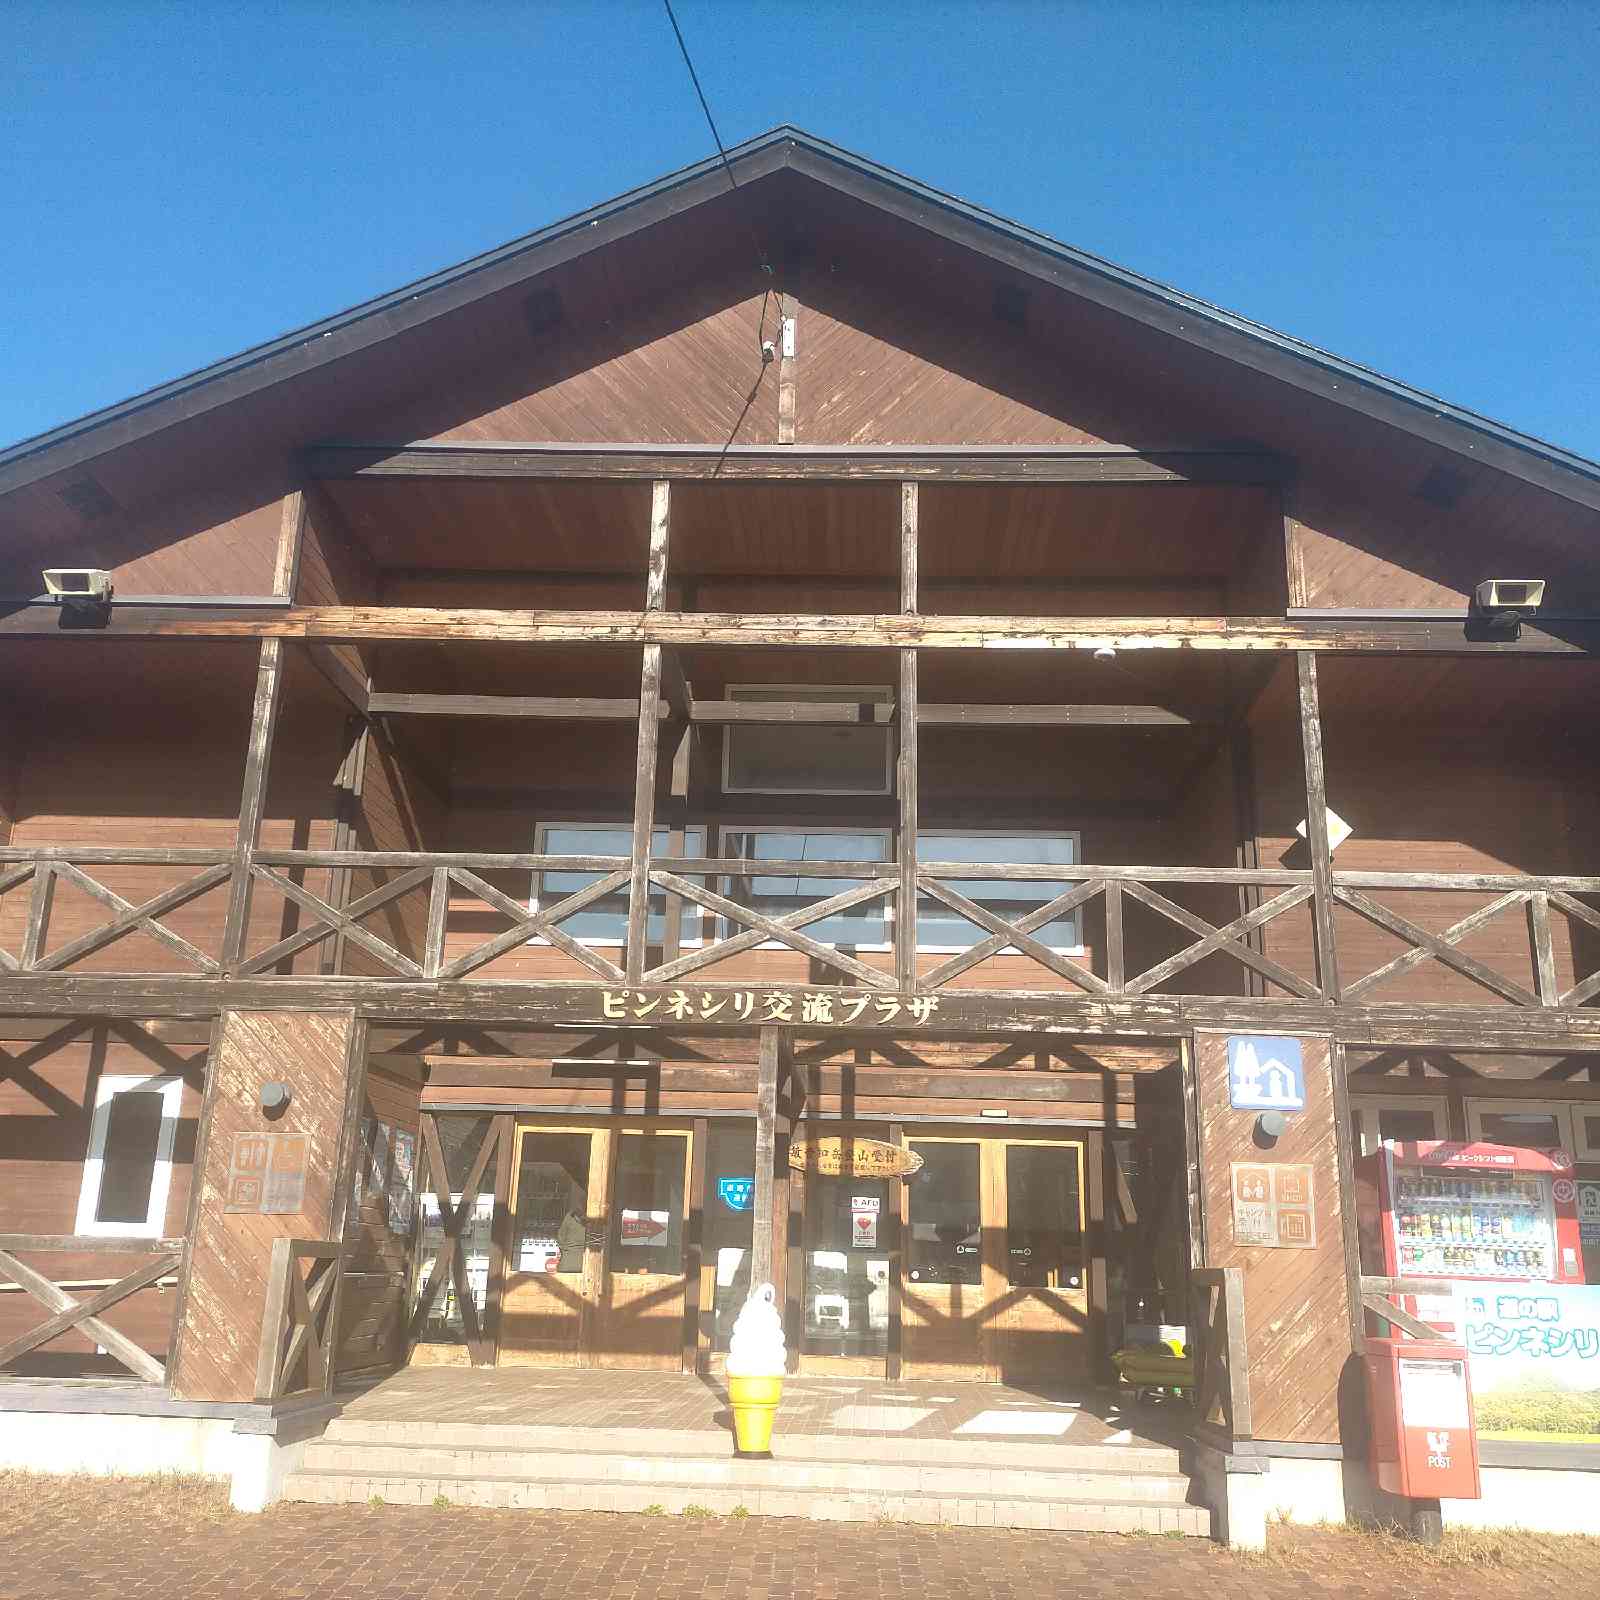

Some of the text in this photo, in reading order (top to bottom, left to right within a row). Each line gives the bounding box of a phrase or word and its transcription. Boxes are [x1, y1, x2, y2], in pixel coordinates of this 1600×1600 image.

[602, 990, 940, 1025] ピンネシリ交流プラザ
[1466, 1323, 1599, 1358] ピンネシリ
[1427, 1455, 1453, 1468] POST
